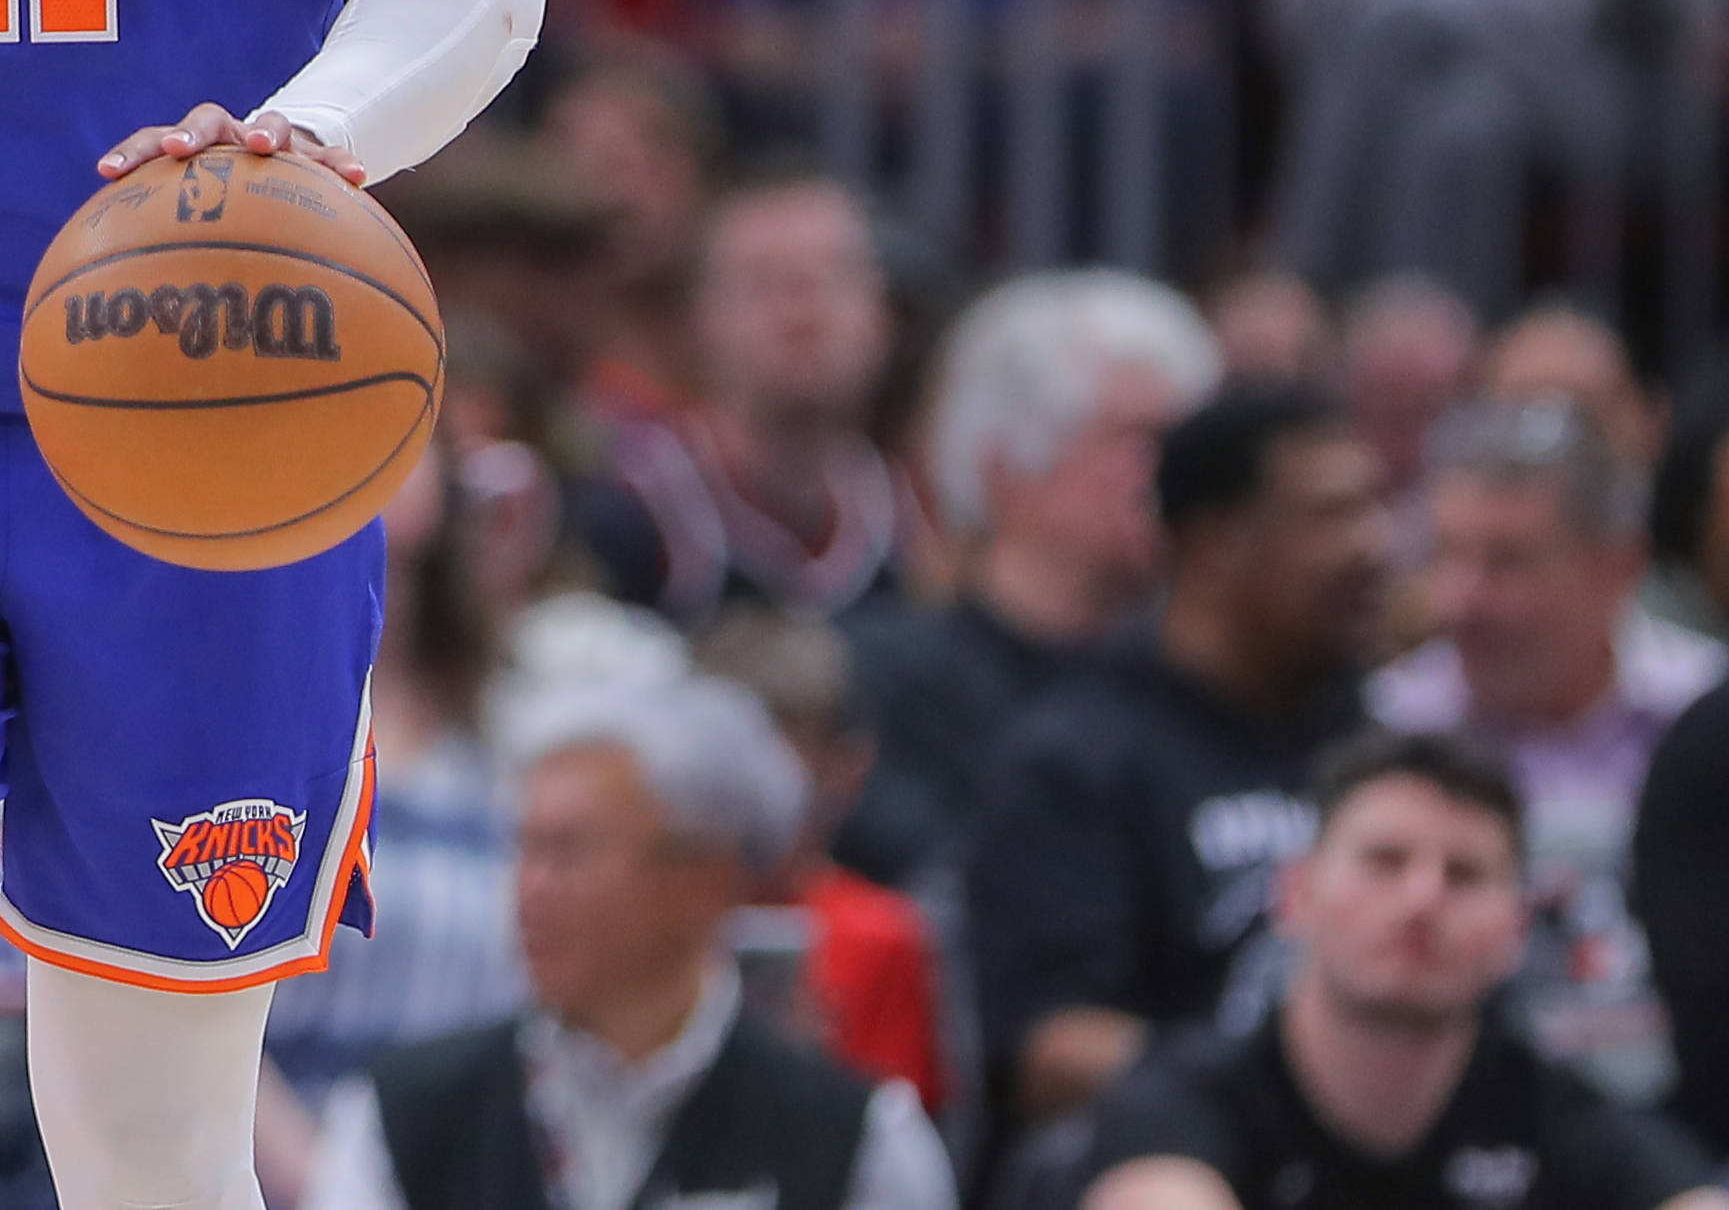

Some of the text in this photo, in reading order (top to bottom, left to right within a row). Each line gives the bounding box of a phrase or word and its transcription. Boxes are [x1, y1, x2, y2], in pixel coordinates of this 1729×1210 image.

[64, 282, 341, 361] Wilson
[164, 813, 296, 869] KNICKS
[215, 804, 272, 823] NEW YORK
